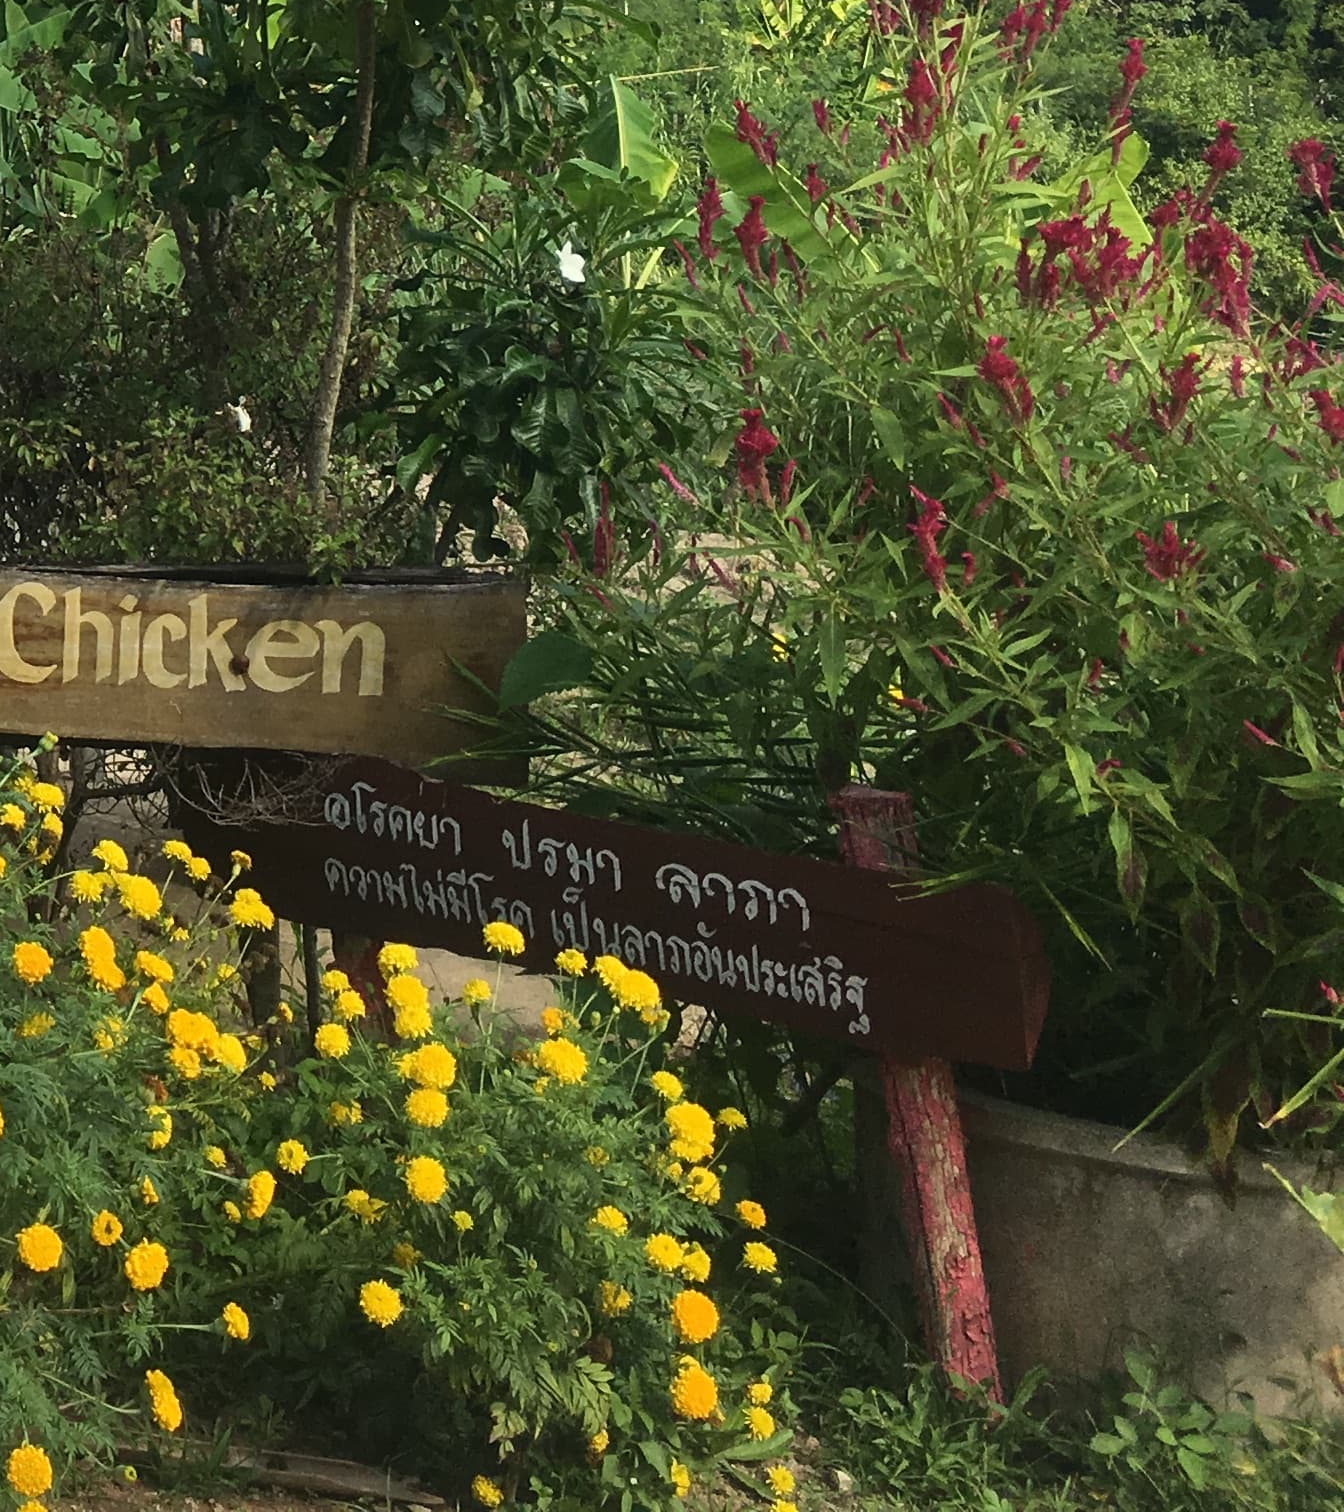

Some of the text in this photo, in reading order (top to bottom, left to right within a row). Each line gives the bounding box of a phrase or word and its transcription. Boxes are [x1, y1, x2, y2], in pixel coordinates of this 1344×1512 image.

[324, 781, 811, 931] อโรคยา ปรมา ลาภา
[324, 856, 871, 1036] ความไม่มีโรค เป็นลาภอันประเสริฐ
